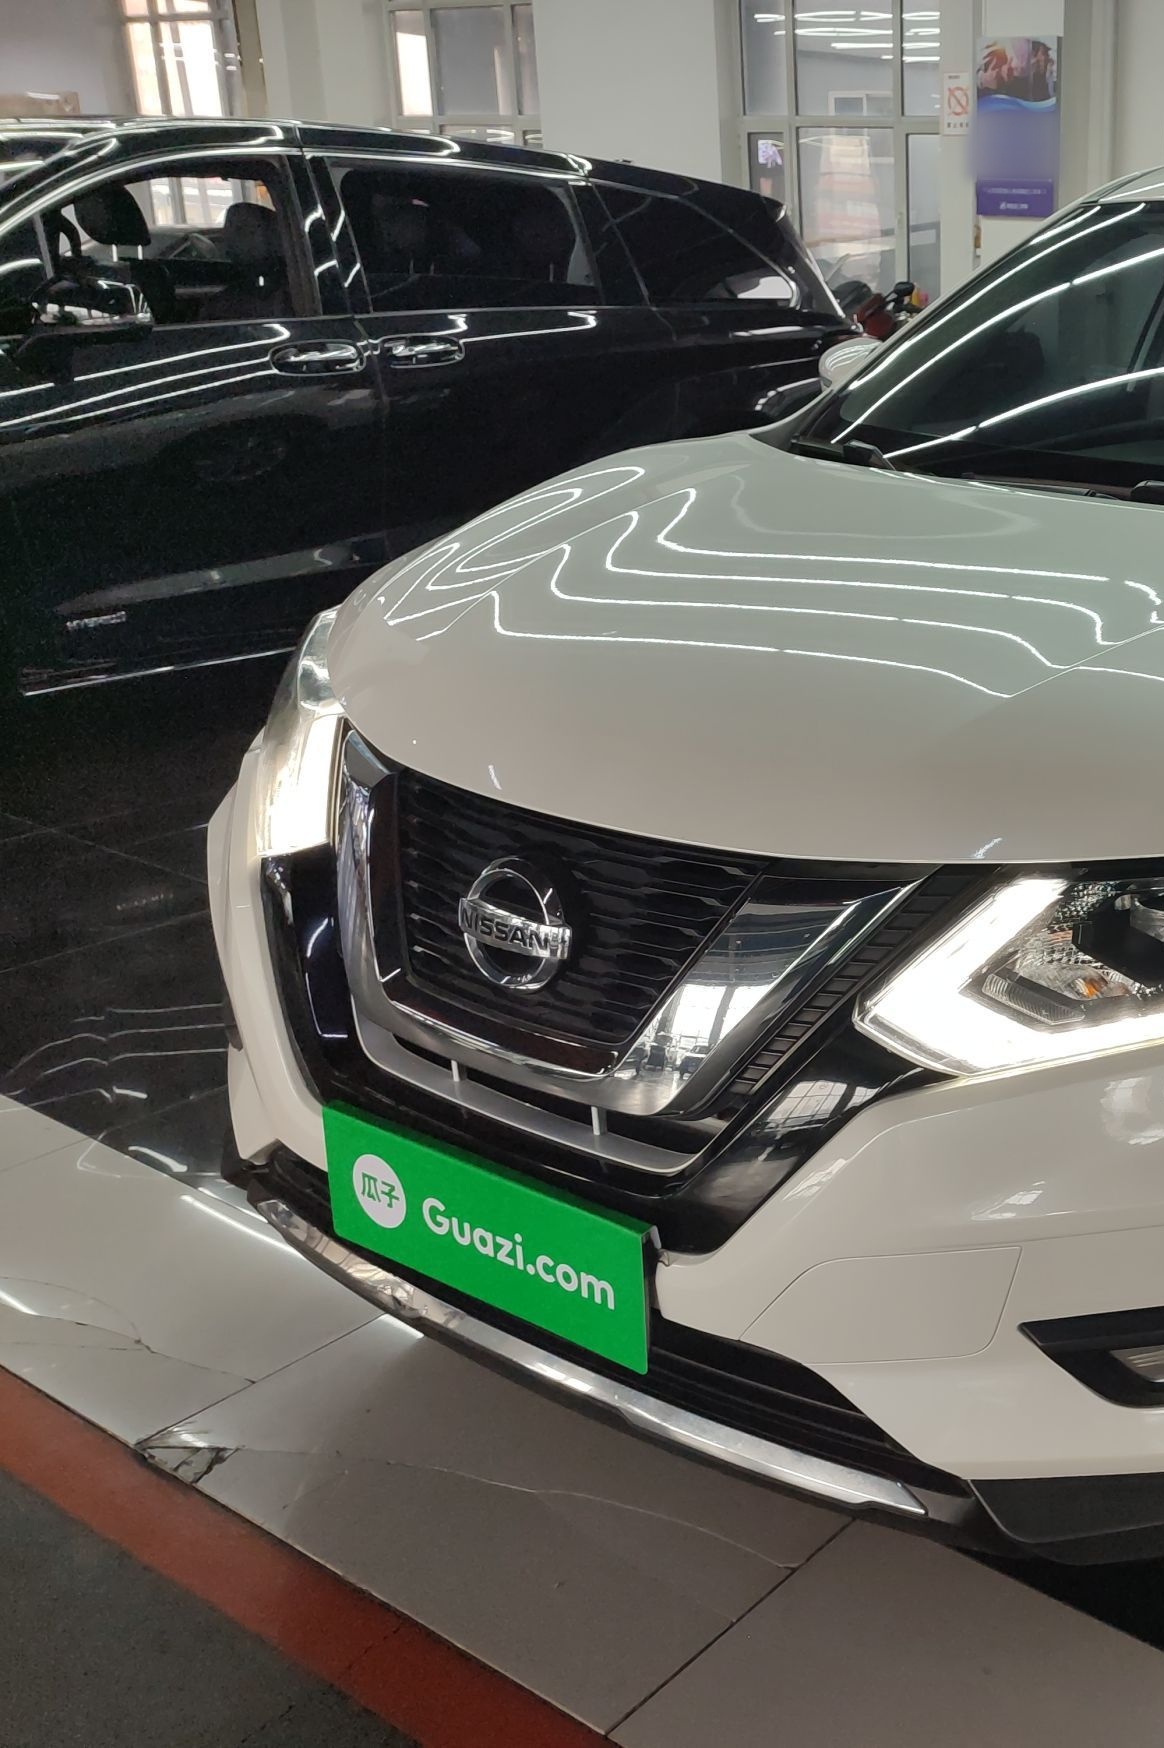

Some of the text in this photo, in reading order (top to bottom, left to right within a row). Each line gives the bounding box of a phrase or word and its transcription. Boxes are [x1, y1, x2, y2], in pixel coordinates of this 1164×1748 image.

[461, 906, 550, 952] NISSAN
[360, 1171, 400, 1209] 瓜子
[422, 1197, 616, 1311] Guazi.com
